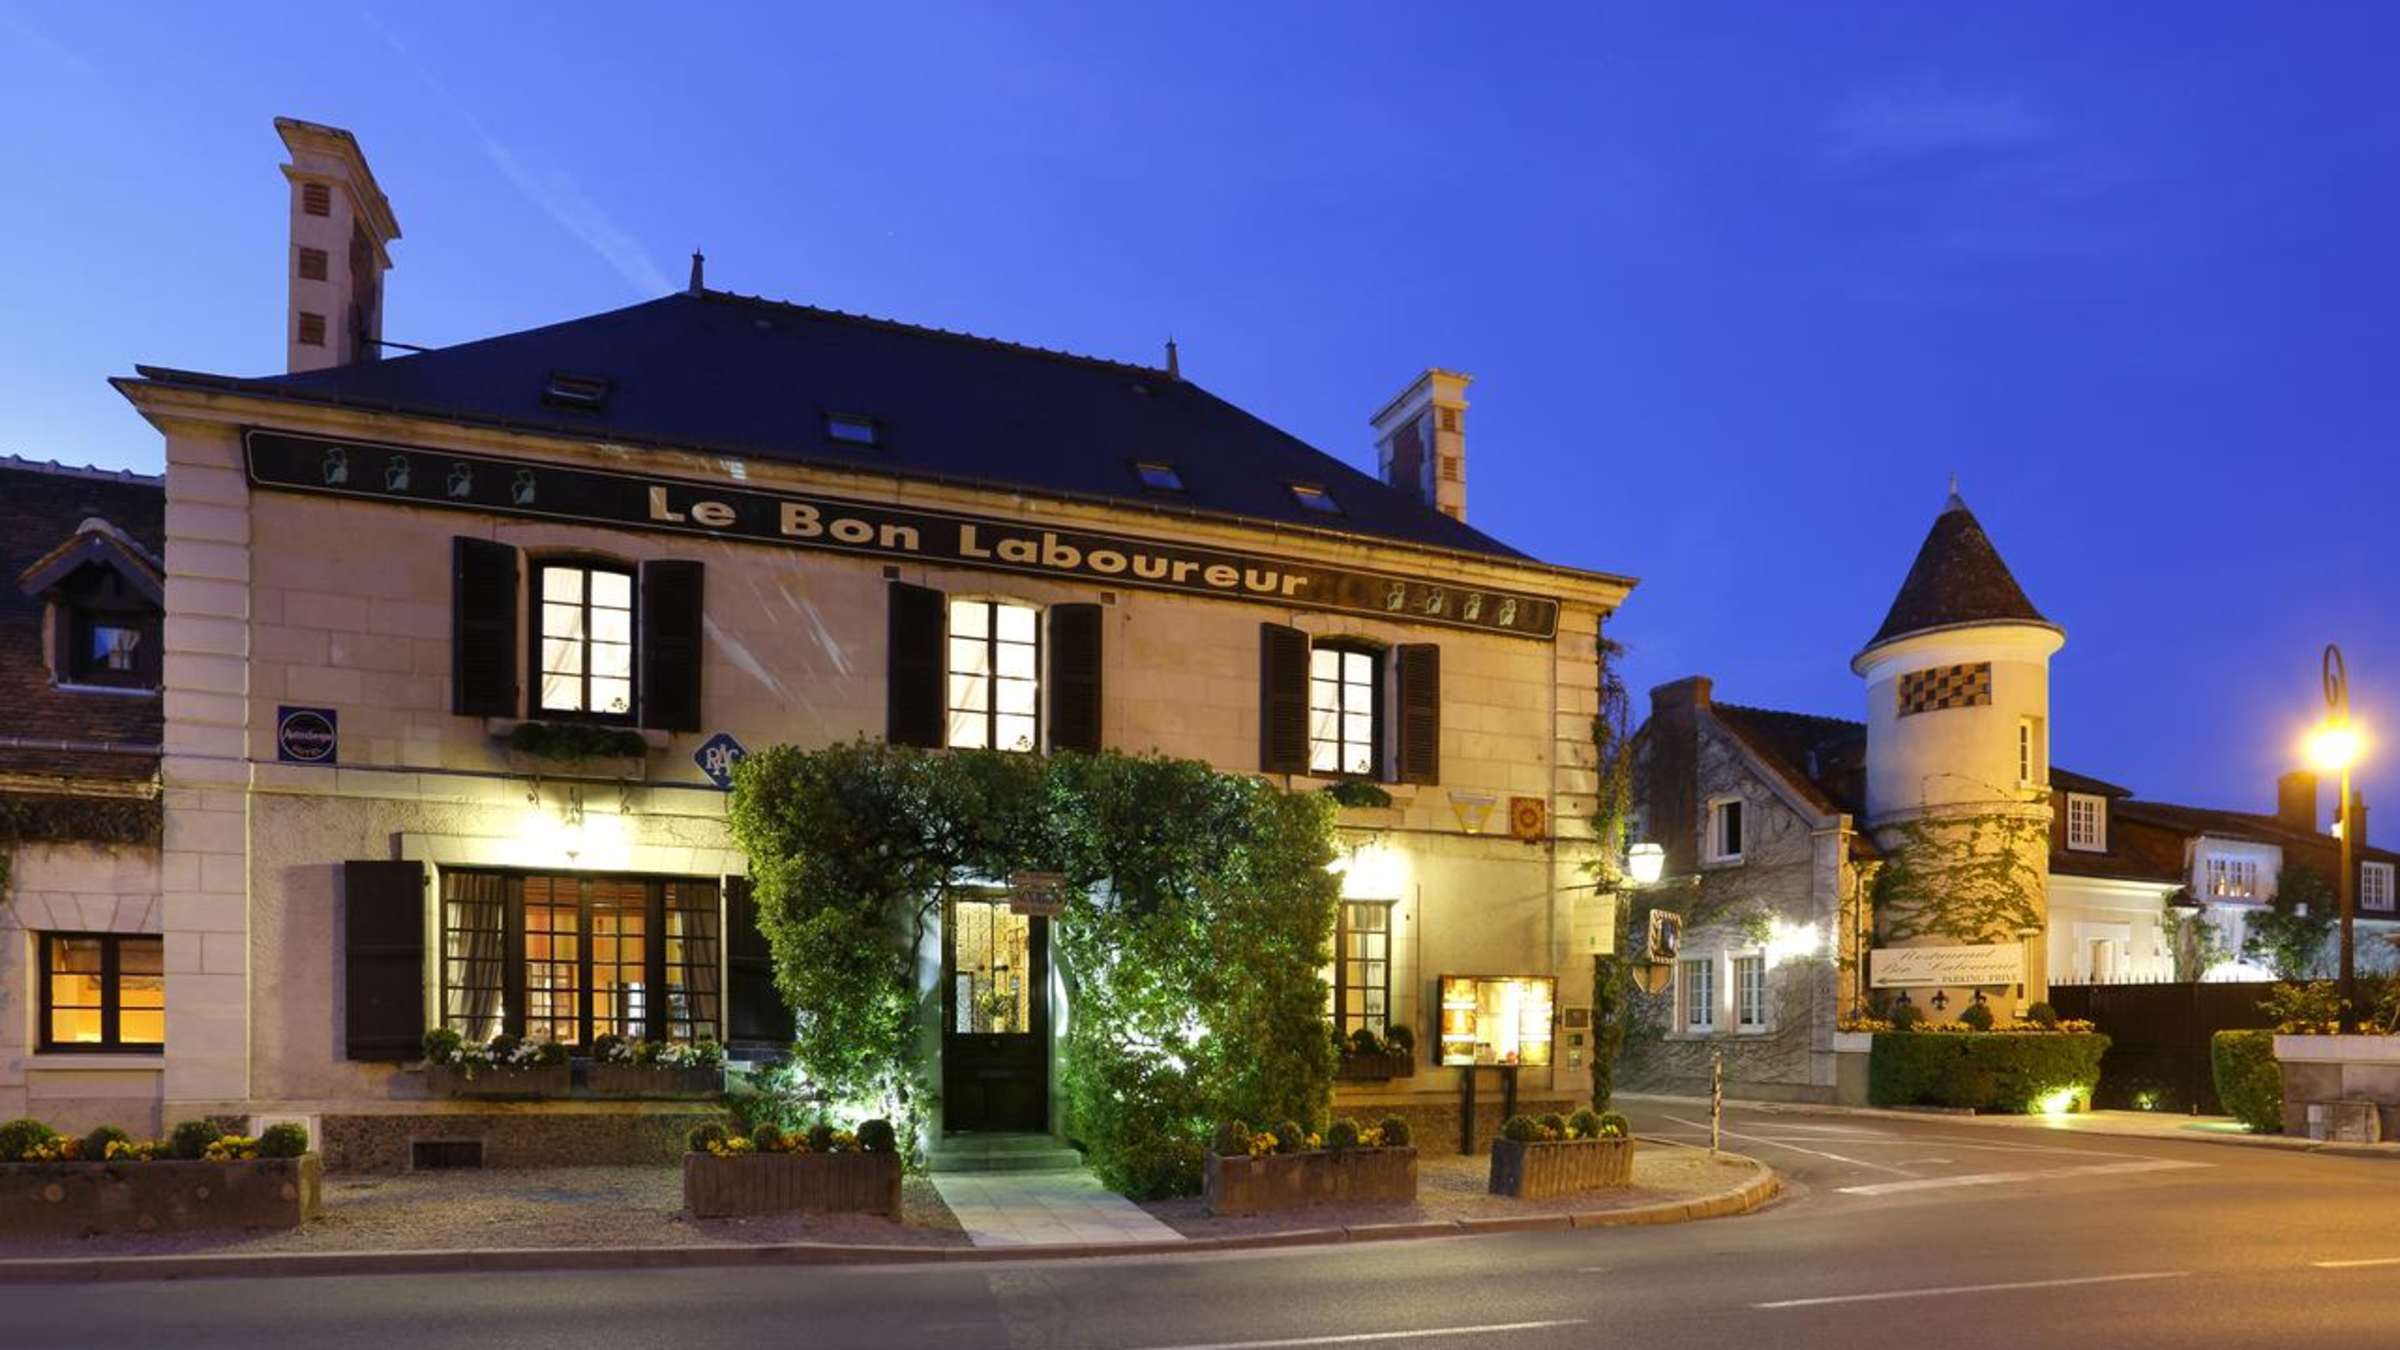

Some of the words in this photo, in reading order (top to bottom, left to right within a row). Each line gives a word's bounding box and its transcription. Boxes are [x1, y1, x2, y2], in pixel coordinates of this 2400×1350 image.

[648, 486, 737, 527] Le
[779, 501, 920, 551] Bon
[959, 524, 1308, 596] Laboureur
[1942, 974, 1985, 983] PARKING
